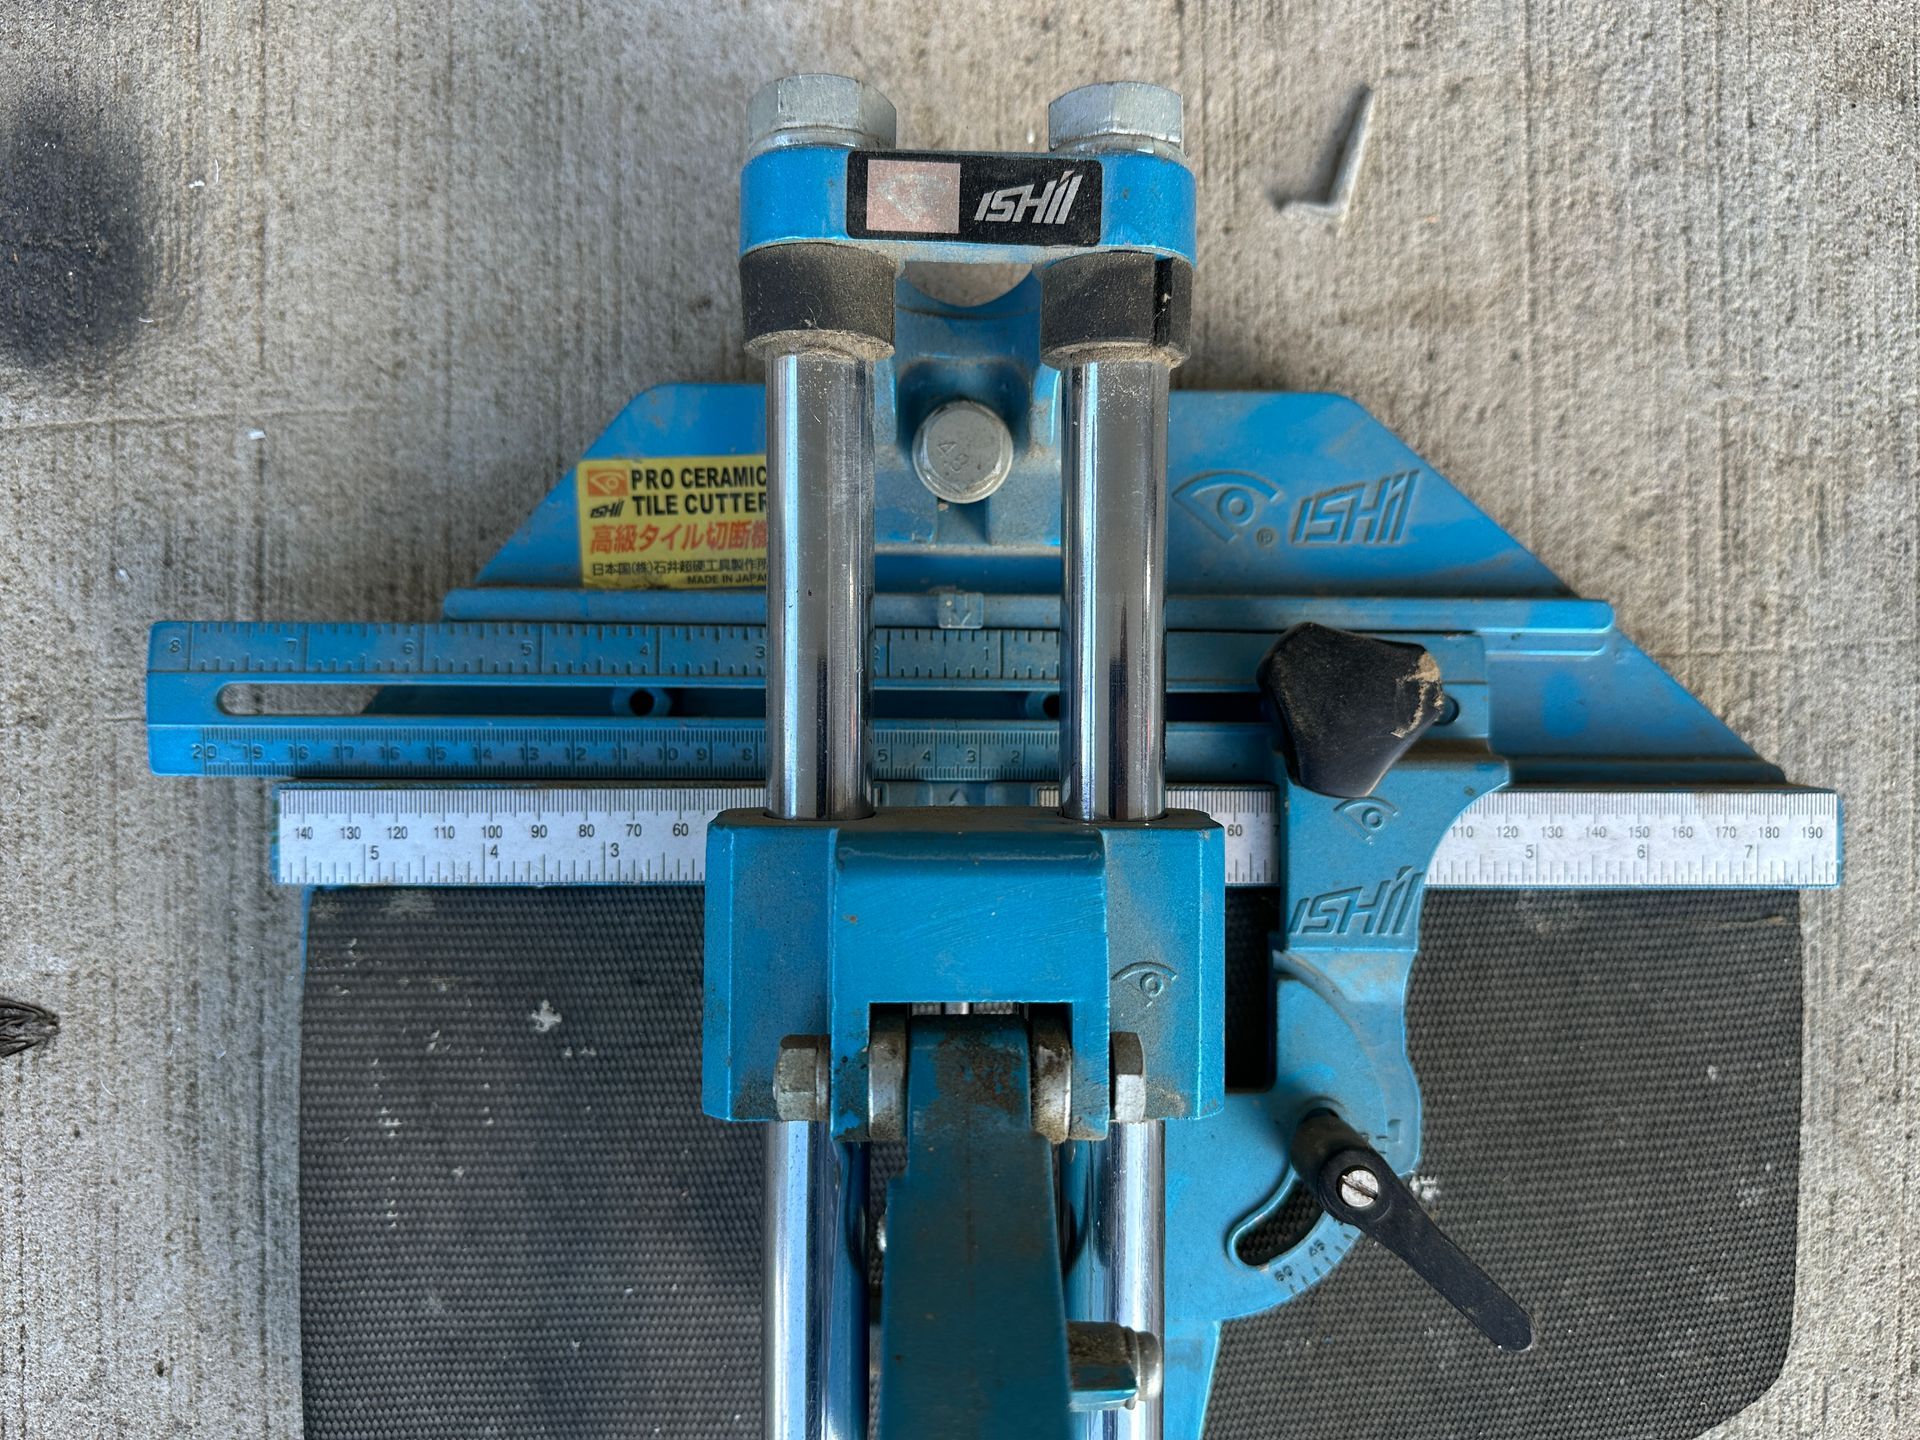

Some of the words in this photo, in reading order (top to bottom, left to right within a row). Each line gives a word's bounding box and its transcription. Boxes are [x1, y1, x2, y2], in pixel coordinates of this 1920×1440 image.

[974, 170, 1083, 225] ISHII
[631, 468, 675, 490] PRO
[681, 465, 767, 489] CERAMIC
[632, 495, 679, 516] TILE
[1290, 468, 1421, 545] ISHII
[687, 574, 718, 585] MADE
[722, 574, 734, 584] IN
[191, 742, 218, 759] 20
[243, 743, 264, 759] 19
[333, 744, 355, 759] 17
[379, 744, 401, 760] 16
[425, 745, 448, 760] 15
[472, 746, 493, 761] 14
[519, 747, 541, 761] 13
[565, 747, 588, 762] 12
[611, 747, 629, 762] 11
[657, 748, 680, 762] 10
[697, 748, 709, 762] 9
[742, 748, 754, 762] 8
[877, 751, 888, 764] 5
[922, 751, 932, 764] 4
[966, 751, 977, 764] 3
[1010, 751, 1020, 764] 2
[295, 827, 314, 840] 140
[340, 827, 362, 840] 130
[386, 826, 409, 840] 120
[434, 825, 455, 839] 110
[481, 825, 503, 839] 100
[531, 824, 548, 838] 90
[578, 824, 595, 838] 80
[626, 823, 642, 838] 70
[672, 823, 689, 837] 60
[1227, 823, 1243, 838] 60
[1451, 826, 1474, 839] 110
[1496, 826, 1519, 839] 120
[1541, 826, 1563, 839] 130
[1585, 826, 1607, 839] 140
[1628, 826, 1650, 839] 150
[1672, 826, 1694, 839] 160
[1716, 826, 1737, 839] 170
[1758, 826, 1780, 839] 180
[1801, 826, 1823, 839] 190
[370, 845, 380, 860] 5
[490, 844, 499, 858] 4
[610, 842, 620, 858] 3
[1525, 844, 1534, 860] 5
[1637, 844, 1646, 860] 6
[1745, 844, 1753, 859] 7
[1287, 865, 1424, 936] ISHII
